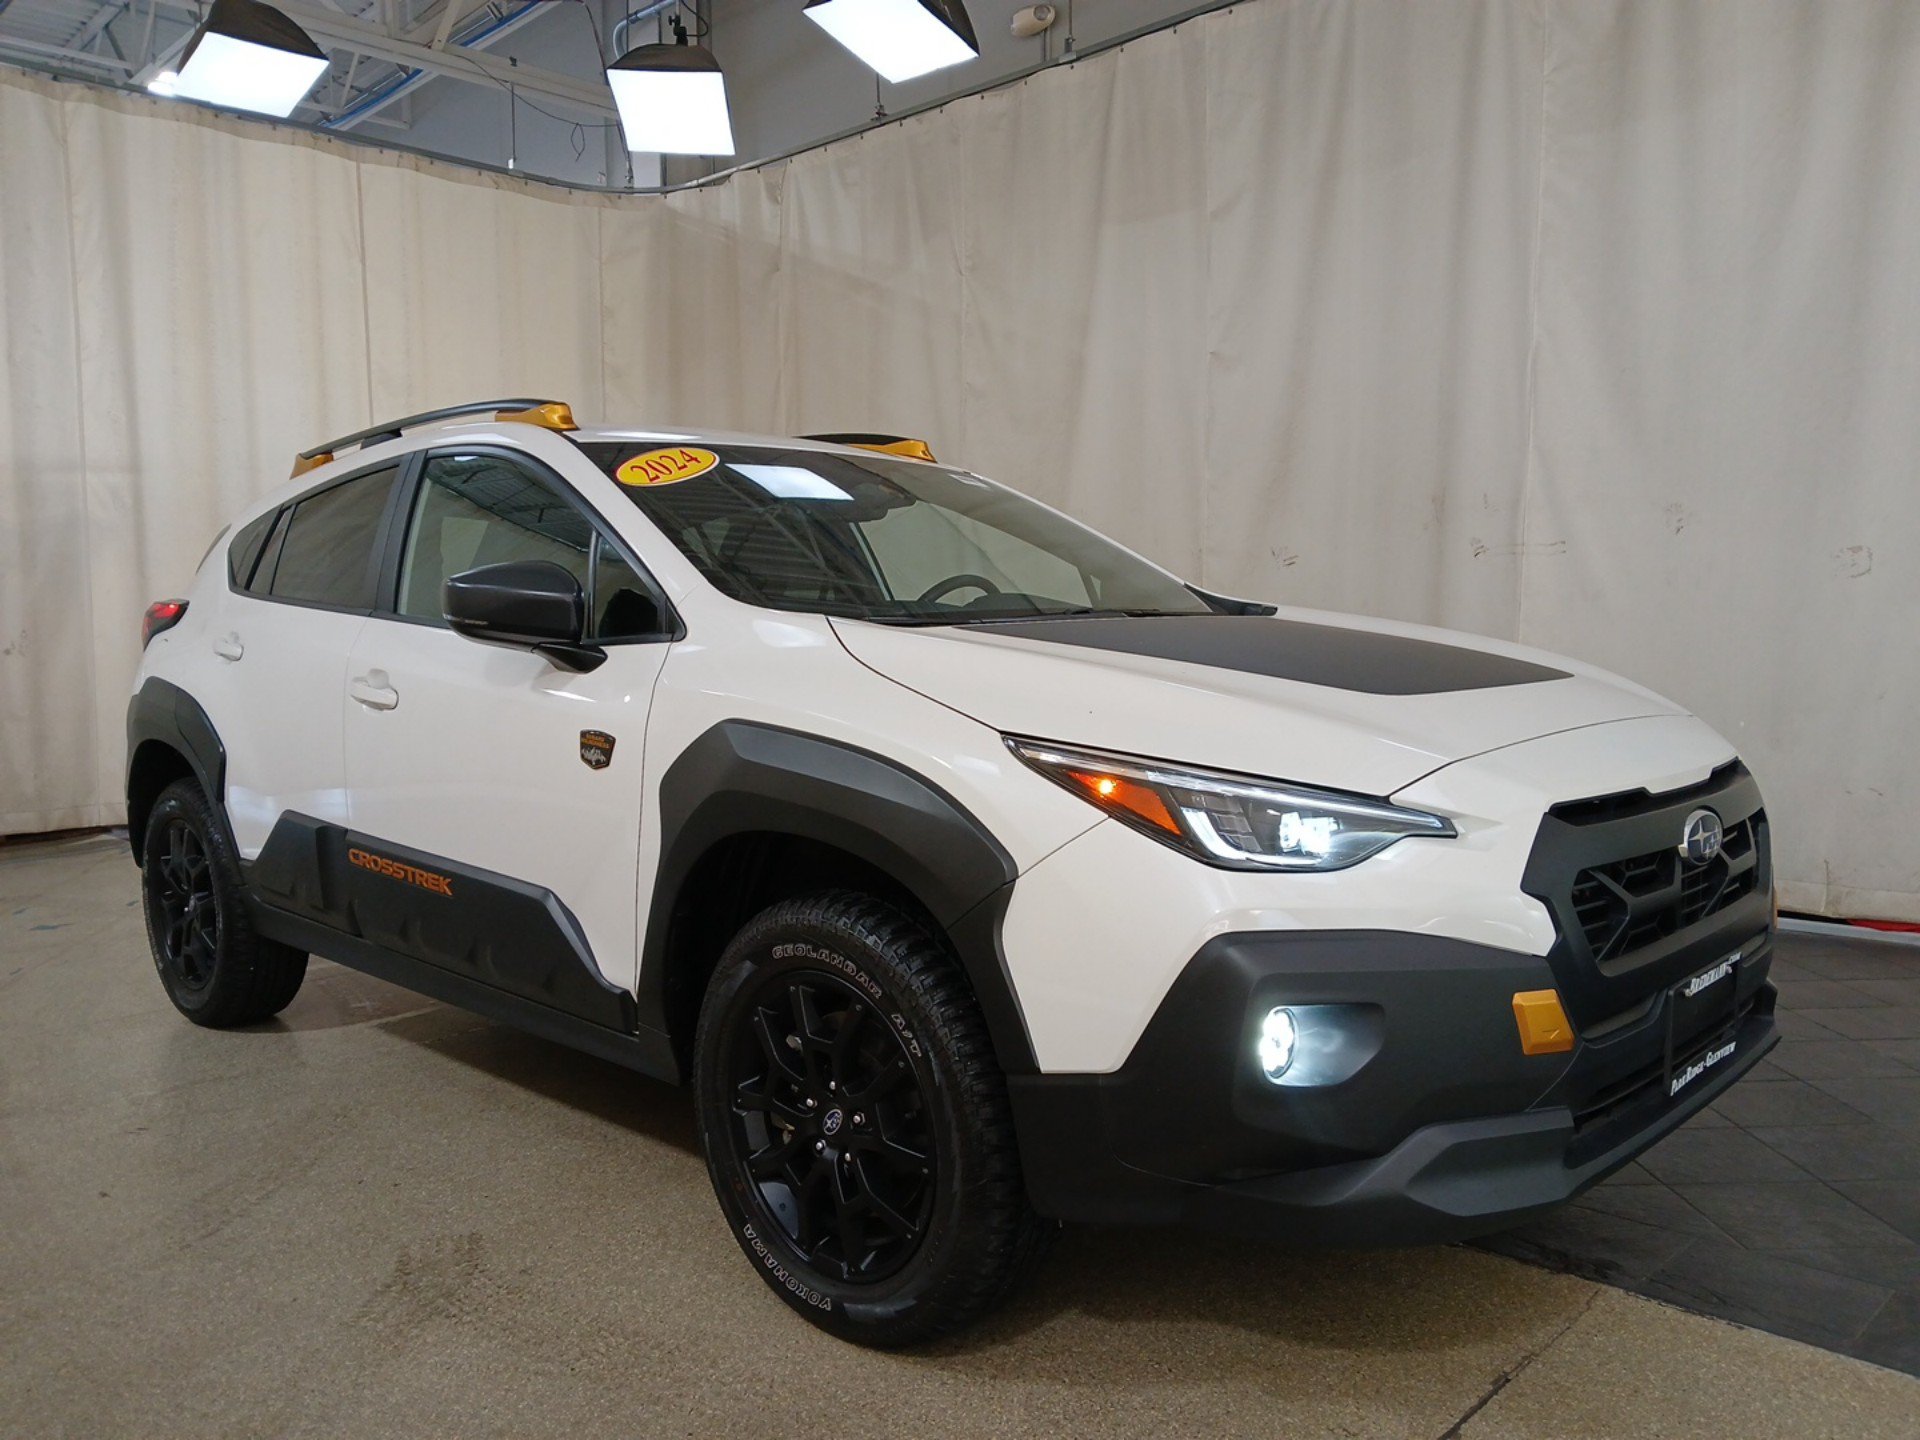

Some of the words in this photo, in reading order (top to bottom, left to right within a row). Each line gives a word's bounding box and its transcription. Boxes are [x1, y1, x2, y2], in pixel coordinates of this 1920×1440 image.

[630, 449, 702, 482] 2024
[348, 848, 453, 896] CROSSTREK
[772, 943, 882, 999] GEOLANDAR
[743, 1223, 832, 1312] YOKOHAMA
